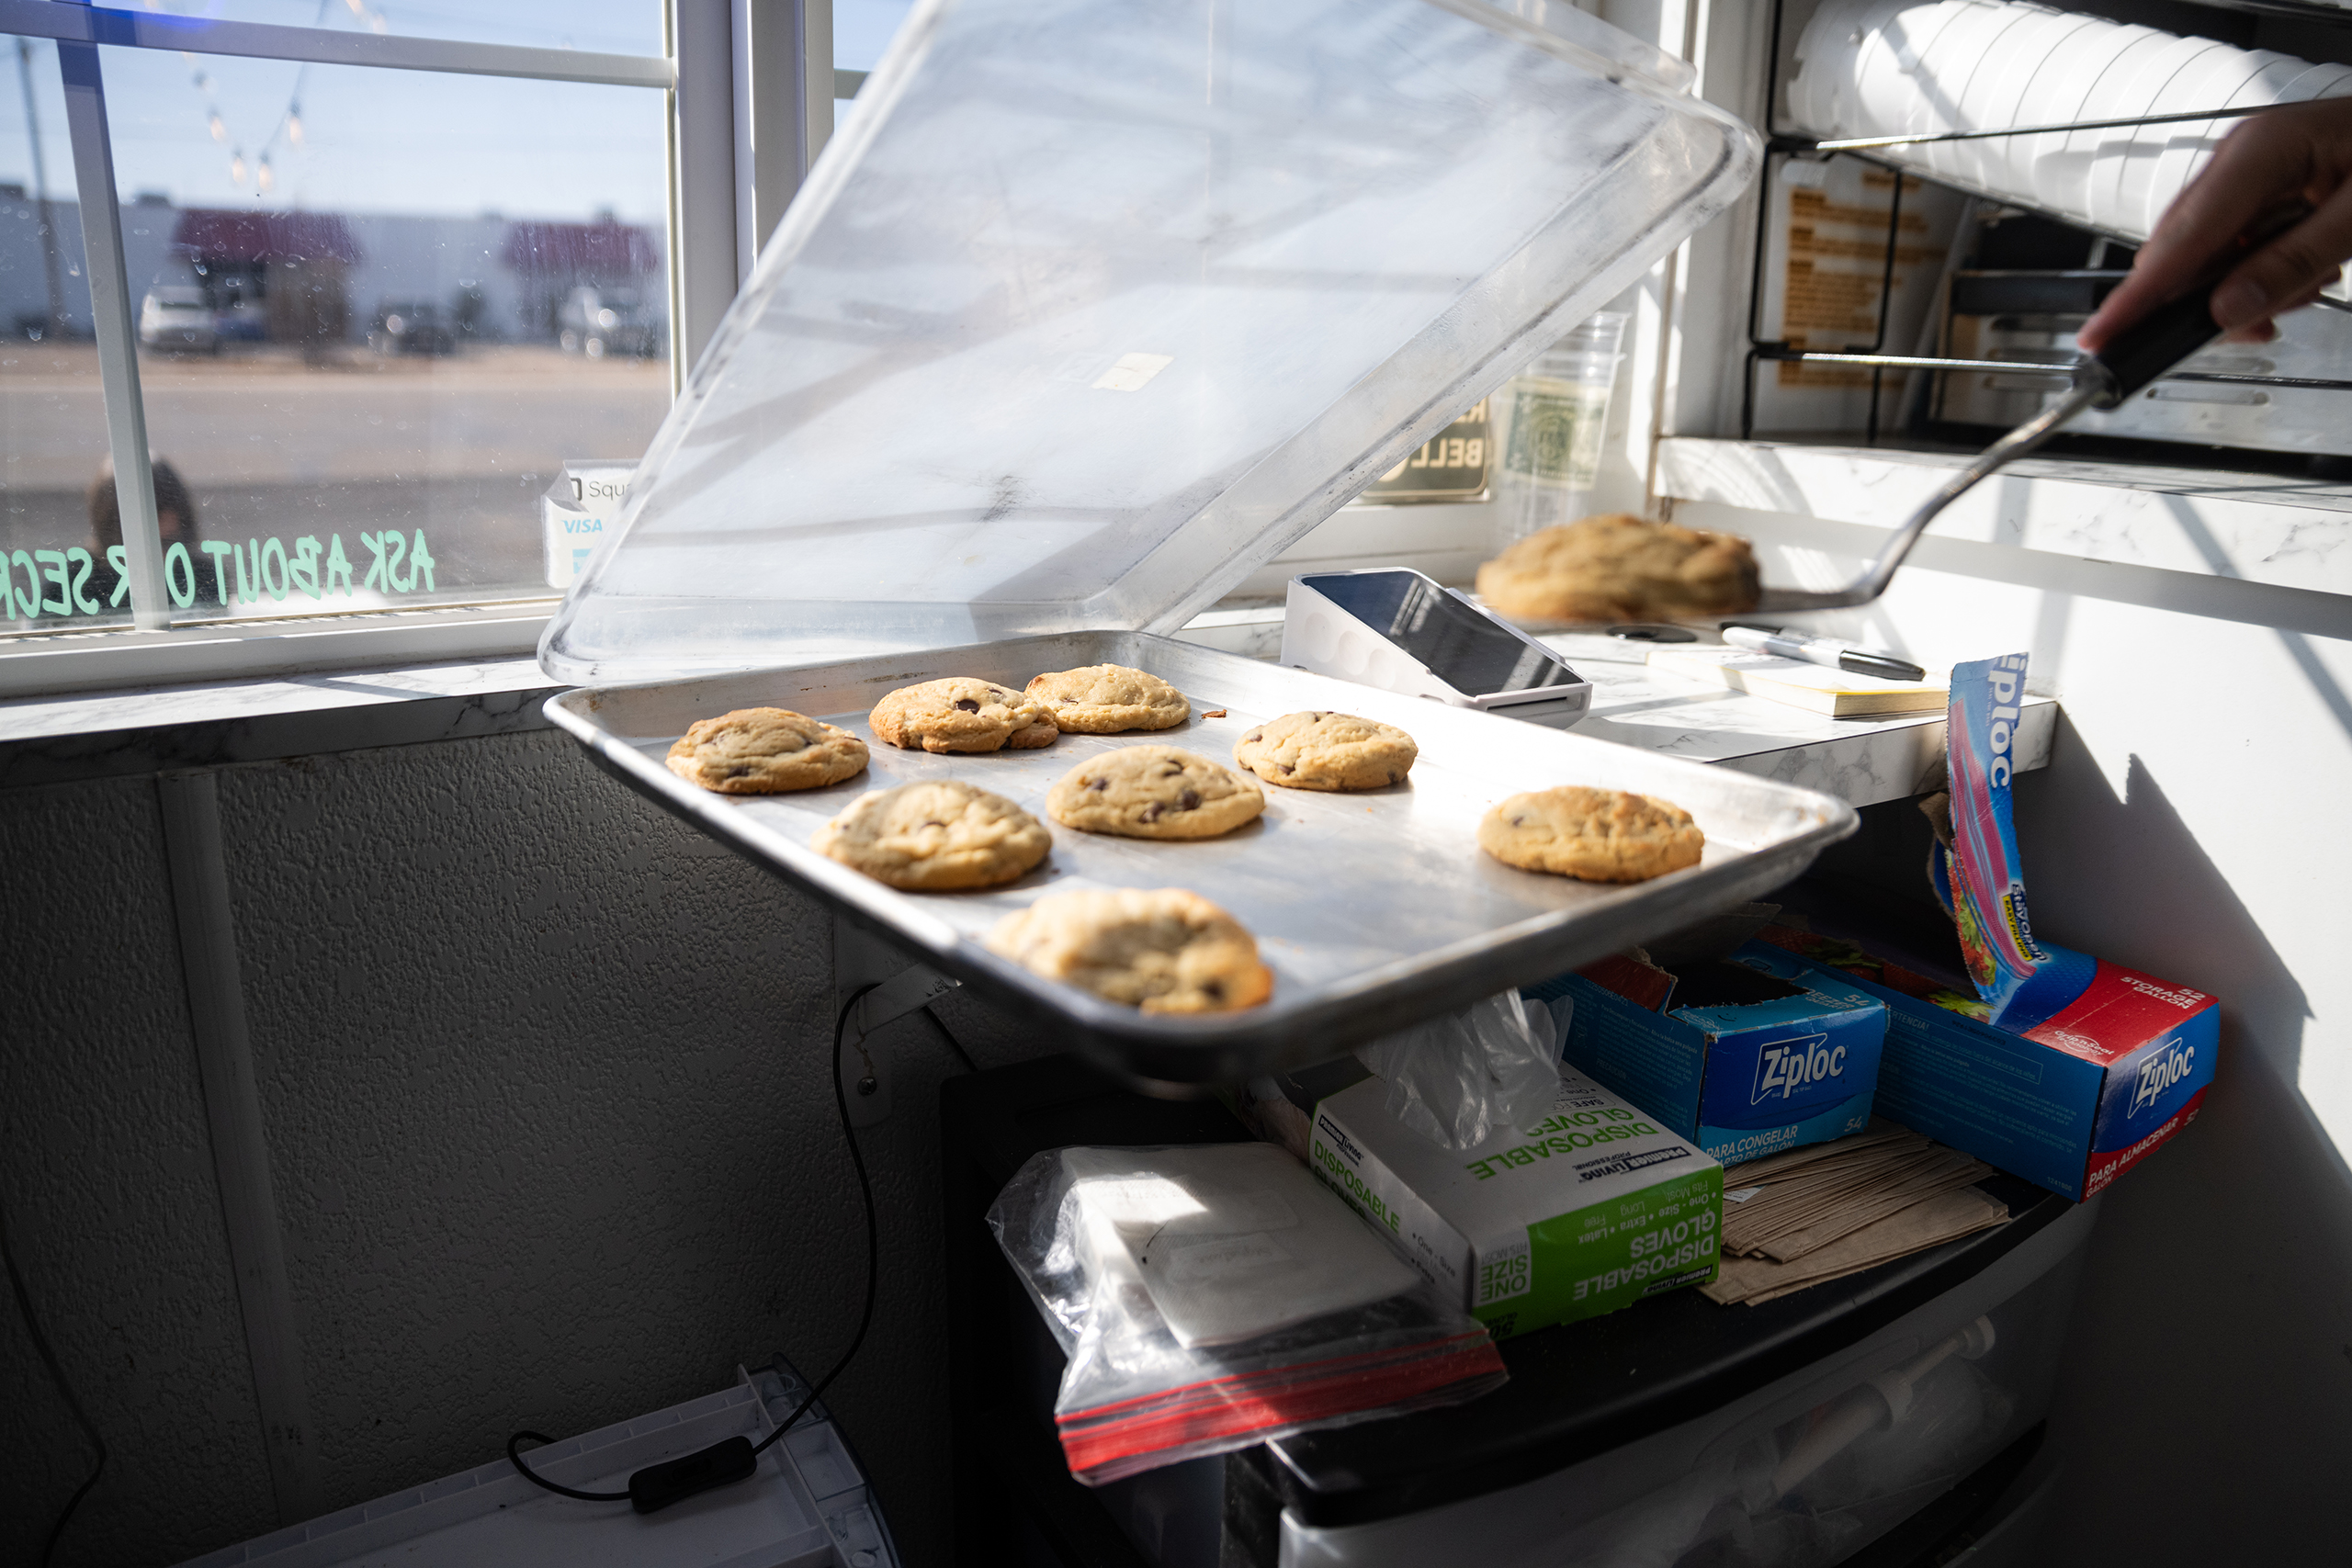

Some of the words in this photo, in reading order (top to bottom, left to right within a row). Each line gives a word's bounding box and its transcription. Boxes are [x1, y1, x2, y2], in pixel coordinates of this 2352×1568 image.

[561, 519, 603, 533] VISA
[1988, 653, 2027, 788] iploc
[1803, 987, 1855, 1009] REEZER
[2120, 976, 2197, 1006] STORAGE
[2132, 987, 2190, 1010] GALLON
[2177, 988, 2205, 1000] 52
[1890, 1010, 1929, 1031] RTENCIA!
[1761, 1043, 1847, 1099] Ziploc
[2135, 1046, 2195, 1107] Ziploc
[1577, 1100, 1604, 1108] SAFE
[1844, 1117, 1862, 1133] 54
[1466, 1122, 1659, 1180] DISPOSABLE
[1706, 1142, 1736, 1158] PARA
[1737, 1125, 1798, 1152] CONGELAR
[2088, 1160, 2117, 1187] PARA
[2118, 1117, 2179, 1168] ALMACENAR
[1572, 1151, 1631, 1171] PROFESSIONAL
[1719, 1154, 1743, 1166] ARTO
[1744, 1149, 1758, 1160] DE
[1758, 1140, 1795, 1156] GALÓN
[1315, 1140, 1400, 1234] DISPOSABLE
[1692, 1180, 1708, 1192] Fits
[1620, 1201, 1645, 1217] Long
[1658, 1202, 1679, 1217] Size
[1689, 1193, 1709, 1207] One
[1584, 1214, 1606, 1228] Free
[1620, 1213, 1646, 1232] Extra
[1577, 1227, 1608, 1245] Latex
[1630, 1211, 1716, 1258] GLOVES
[1418, 1236, 1433, 1256] One
[1440, 1256, 1455, 1277] Size
[1480, 1255, 1528, 1281] SIZE
[1572, 1234, 1714, 1302] DISPOSABLE
[1480, 1274, 1526, 1302] ONE
[1485, 1312, 1517, 1326] GLOVE
